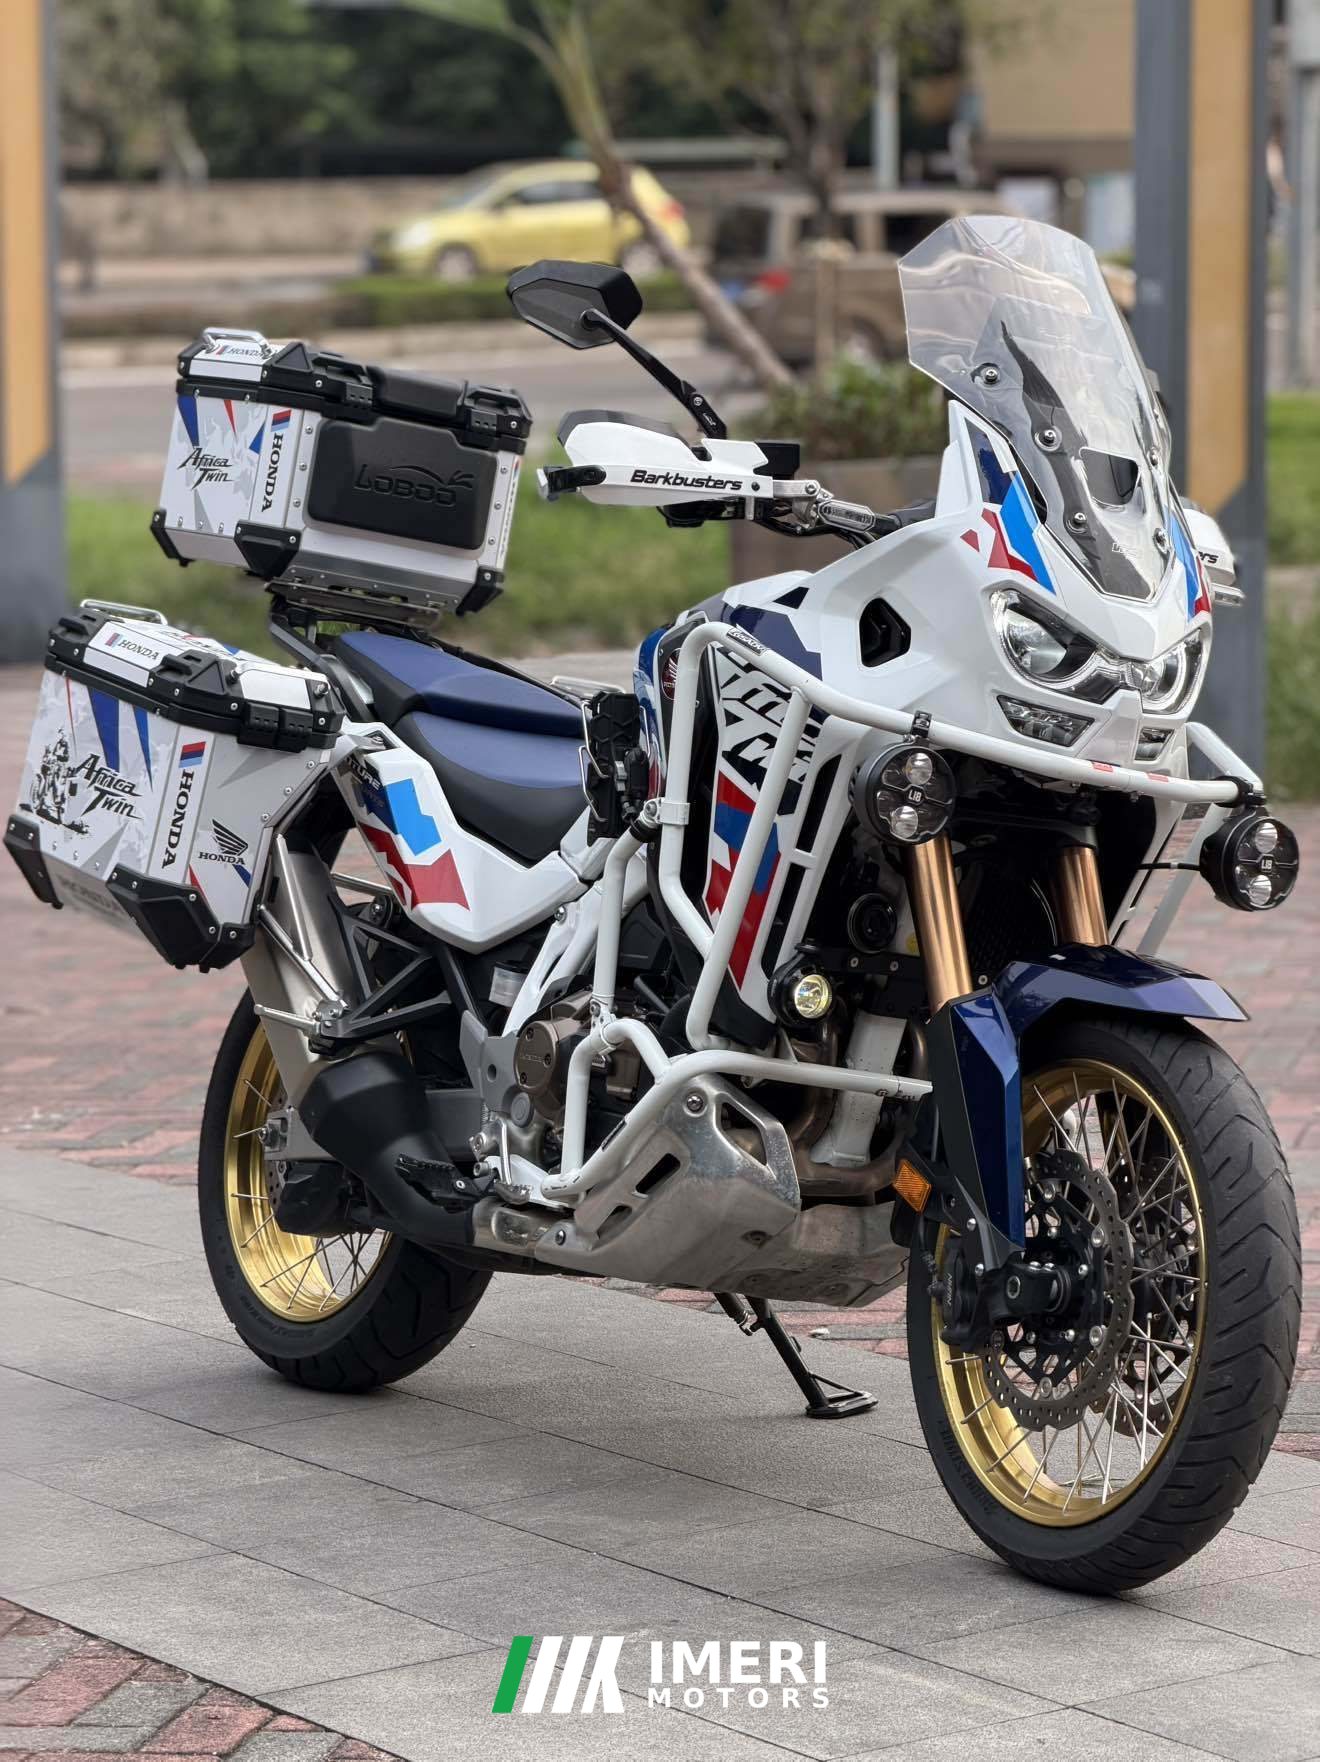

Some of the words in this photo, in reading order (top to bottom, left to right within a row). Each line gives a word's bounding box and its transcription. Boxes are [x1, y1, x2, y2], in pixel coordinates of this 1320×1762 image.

[177, 447, 233, 471] Africa
[190, 467, 236, 490] Twin
[261, 432, 284, 513] HONDA
[630, 469, 743, 491] Barkbusters
[118, 639, 160, 660] HONDA
[72, 753, 143, 797] Africa
[80, 785, 144, 820] Twin
[161, 768, 195, 869] HONDA
[198, 851, 246, 866] HONDA
